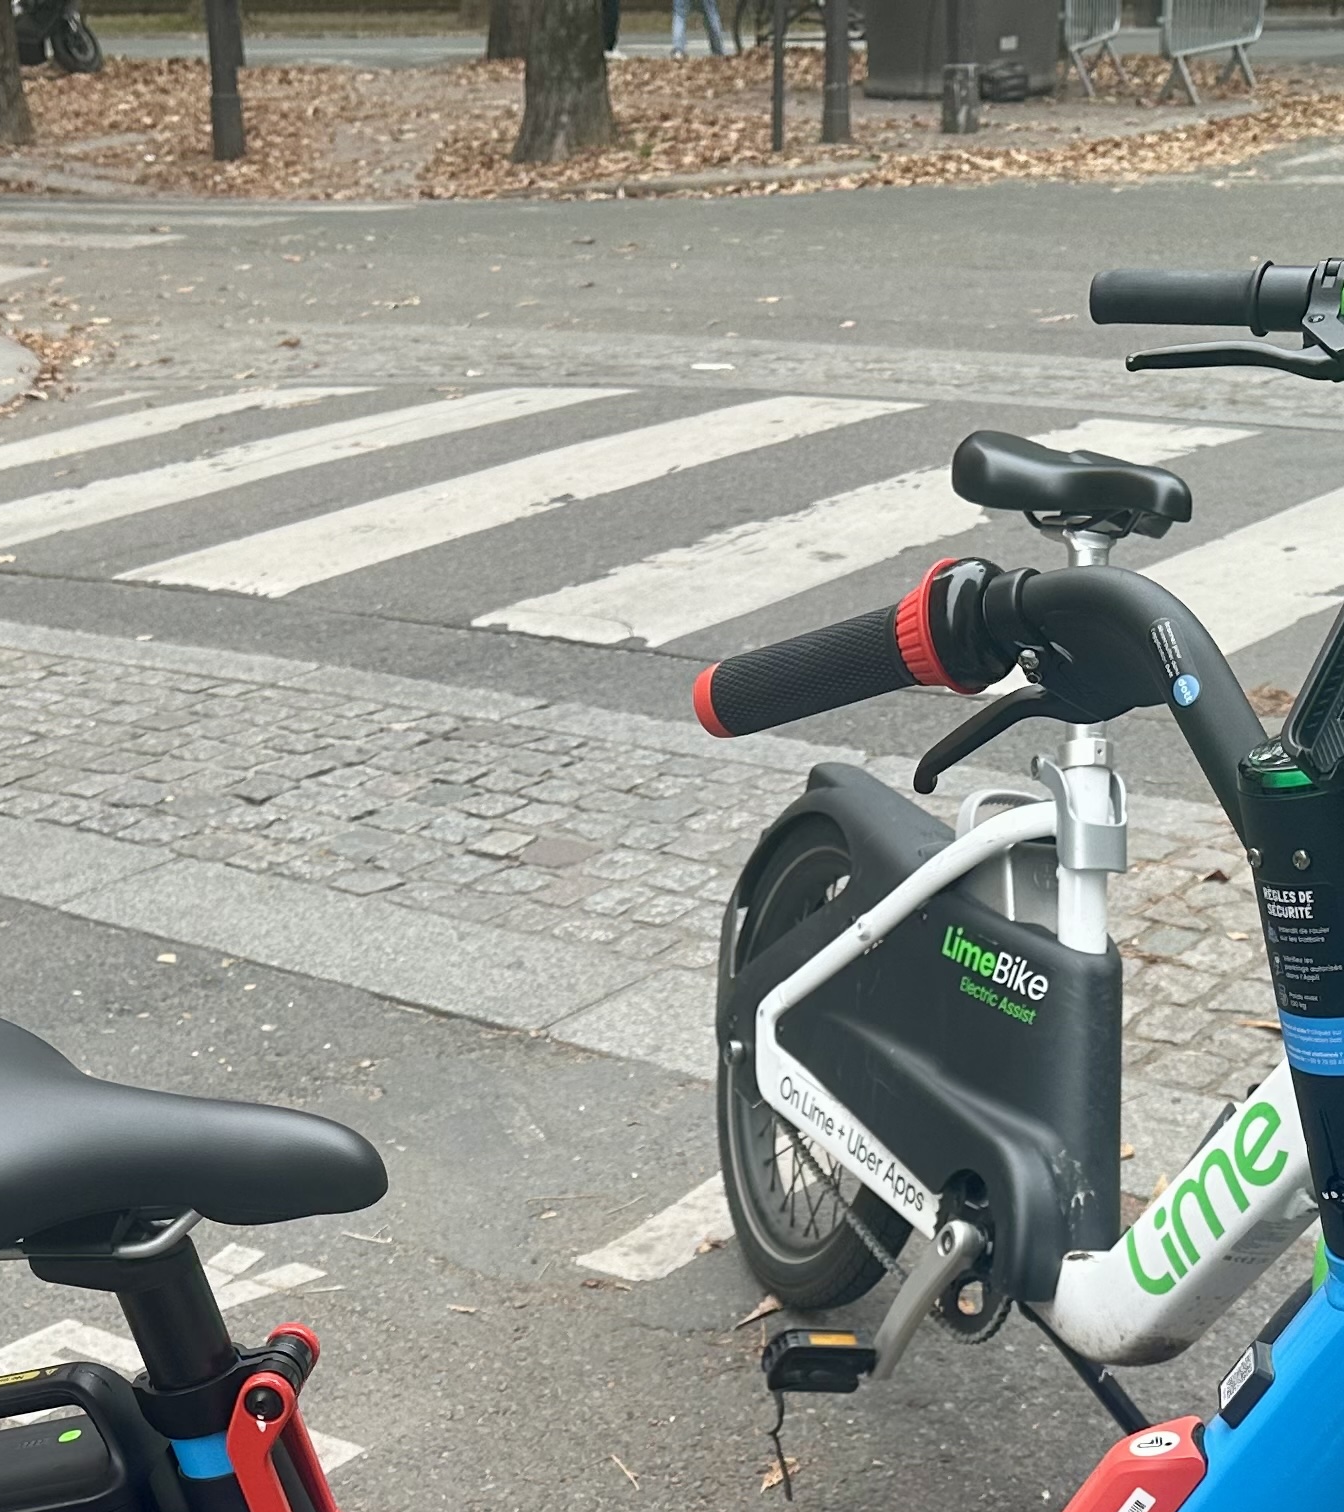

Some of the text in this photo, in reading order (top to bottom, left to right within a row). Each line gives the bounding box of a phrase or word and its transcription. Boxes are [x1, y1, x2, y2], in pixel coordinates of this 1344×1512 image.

[1178, 678, 1194, 704] dott
[1267, 902, 1314, 919] SÉCURITÉ
[1298, 890, 1314, 904] DE
[941, 925, 1050, 1001] LimeBike
[960, 976, 1037, 1026] Electric Assist
[780, 1076, 925, 1212] On Lime + Uber Apps
[1126, 1102, 1288, 1296] Lime
